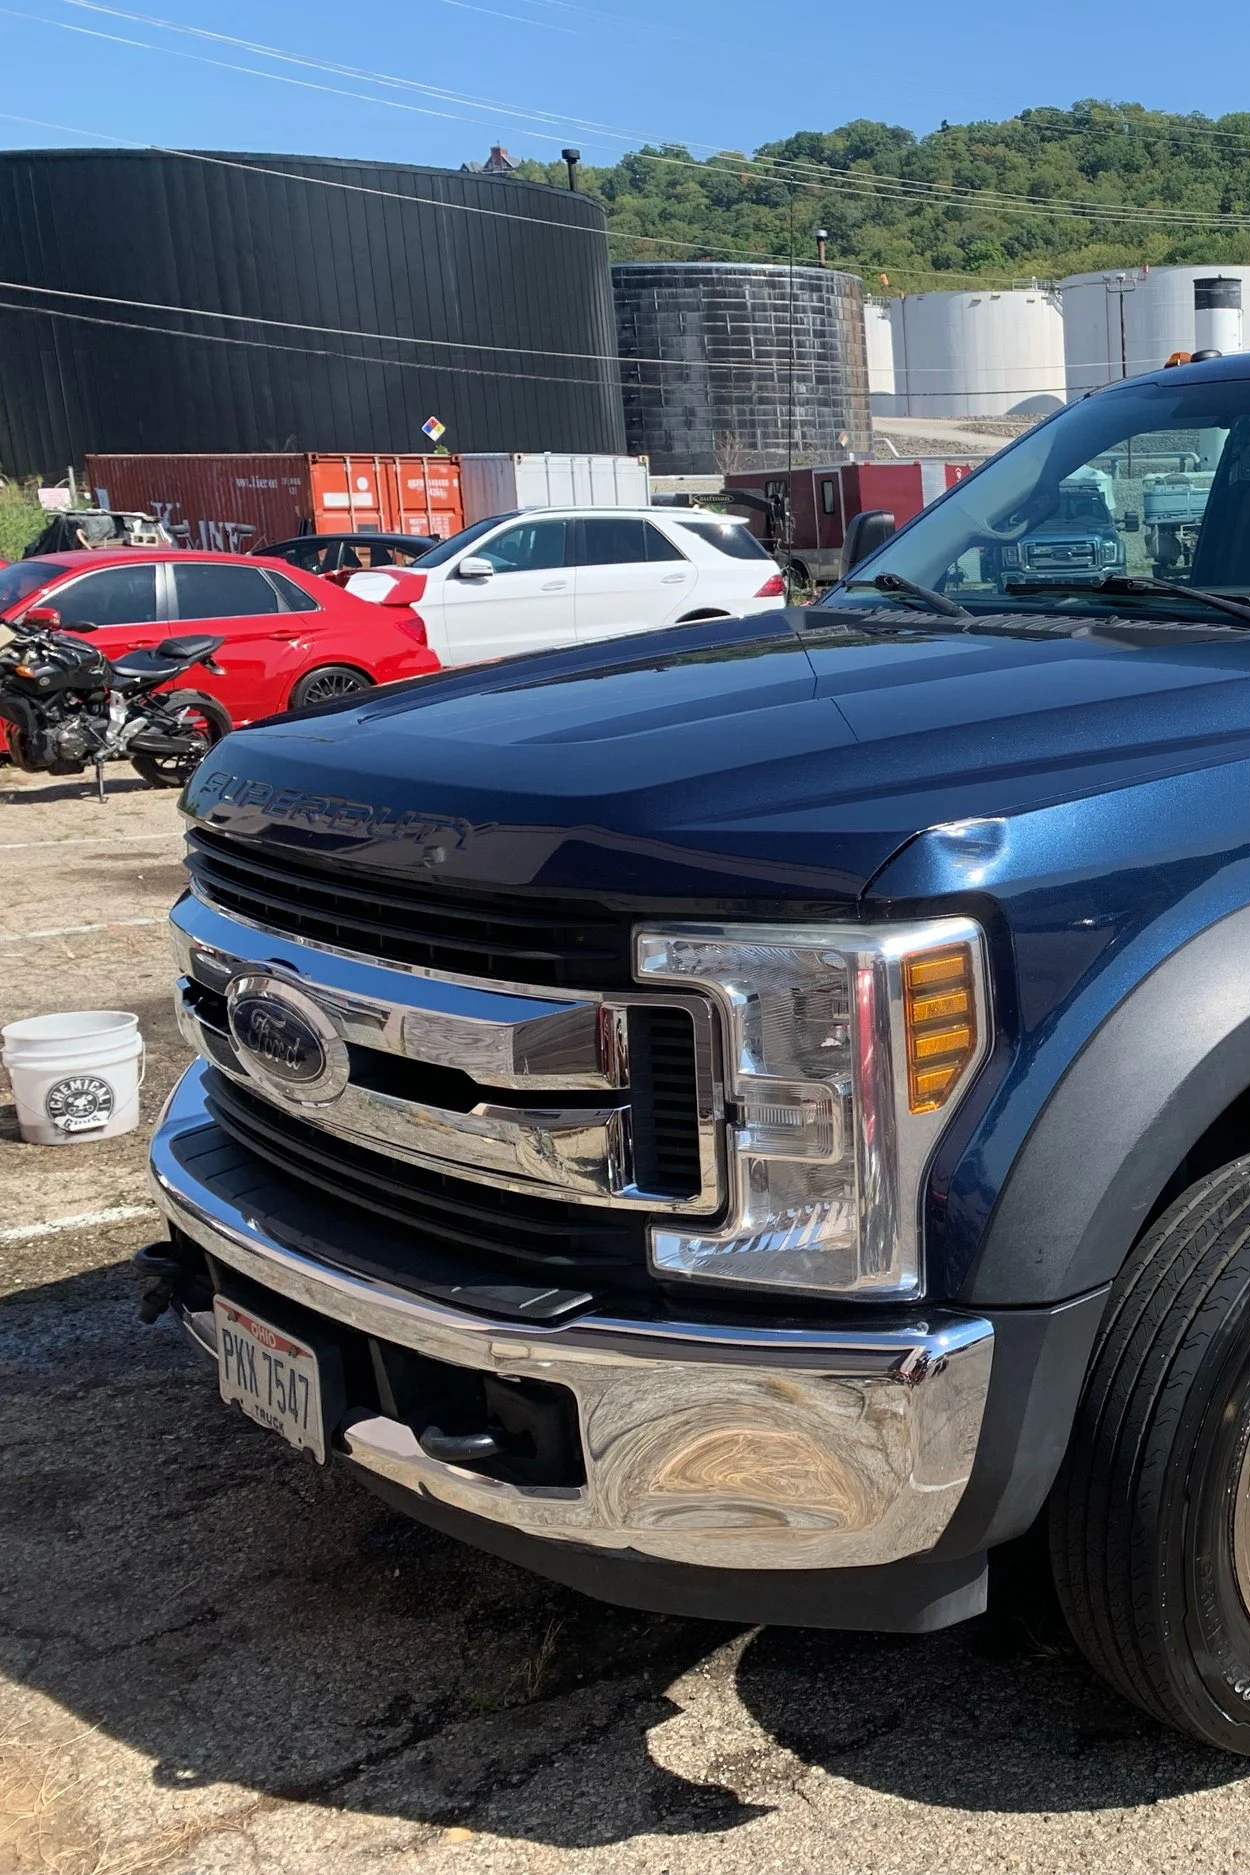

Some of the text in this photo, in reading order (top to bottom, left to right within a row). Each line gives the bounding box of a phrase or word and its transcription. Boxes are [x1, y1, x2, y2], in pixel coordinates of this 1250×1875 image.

[251, 1008, 301, 1071] Ford
[50, 1079, 110, 1109] CHEMICAL
[250, 1322, 276, 1348] OHIO
[222, 1328, 309, 1430] PKX 7547
[254, 1405, 285, 1436] TRUCK
